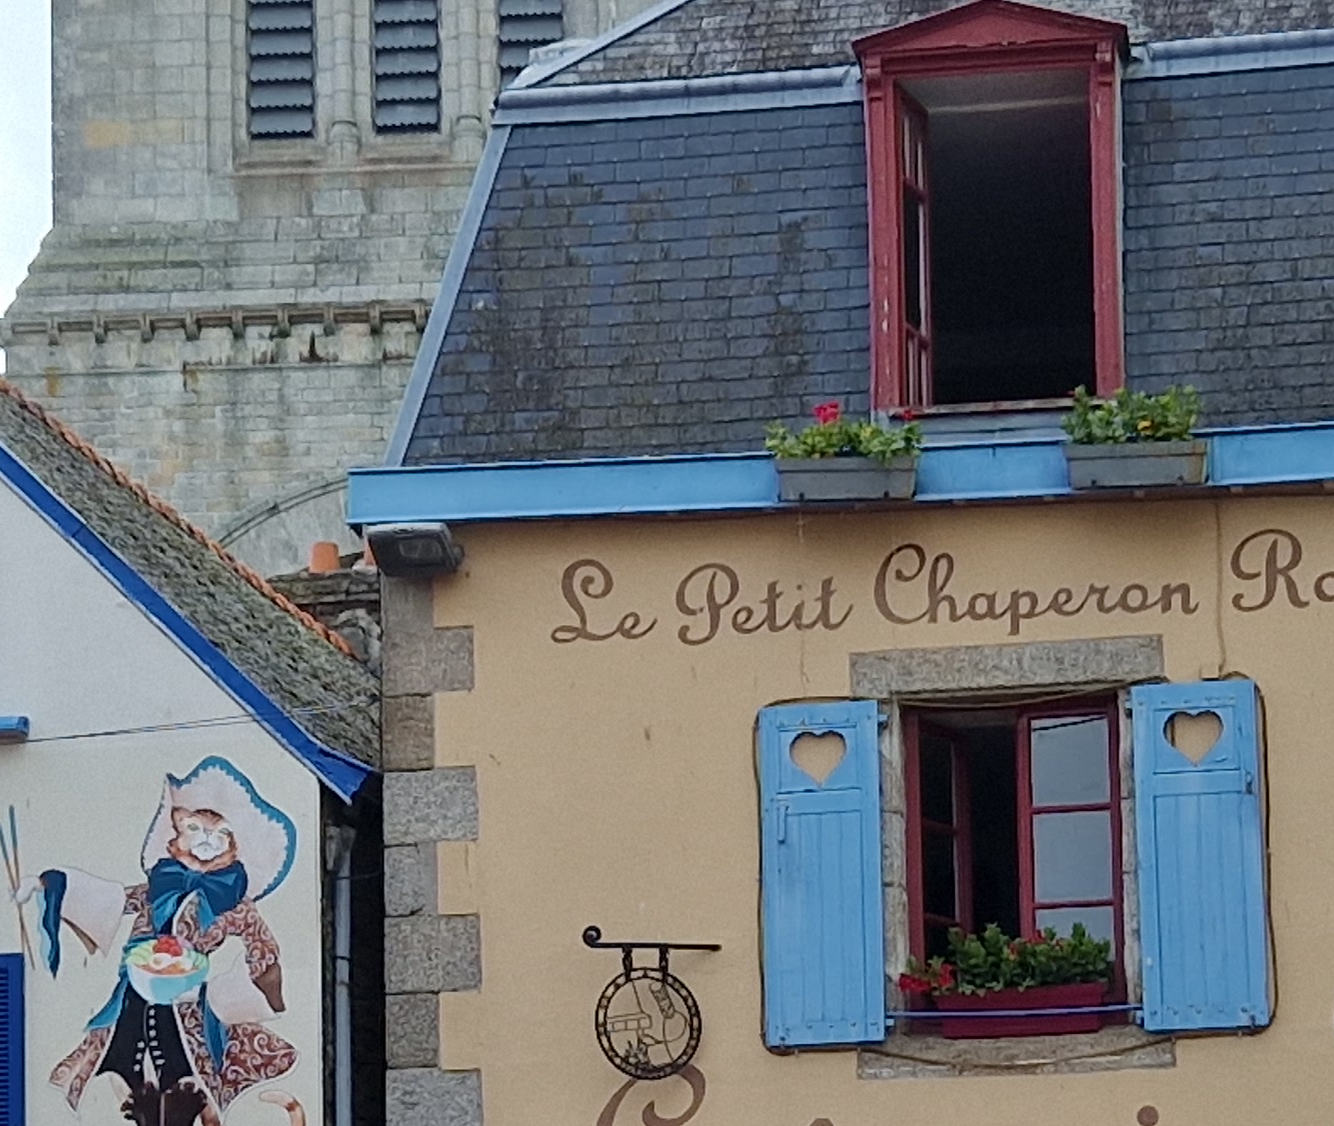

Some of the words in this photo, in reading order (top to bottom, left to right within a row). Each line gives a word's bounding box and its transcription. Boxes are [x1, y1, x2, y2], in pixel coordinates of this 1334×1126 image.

[550, 558, 657, 644] Le
[674, 562, 854, 646] Petit
[873, 543, 1199, 637] Chaperon
